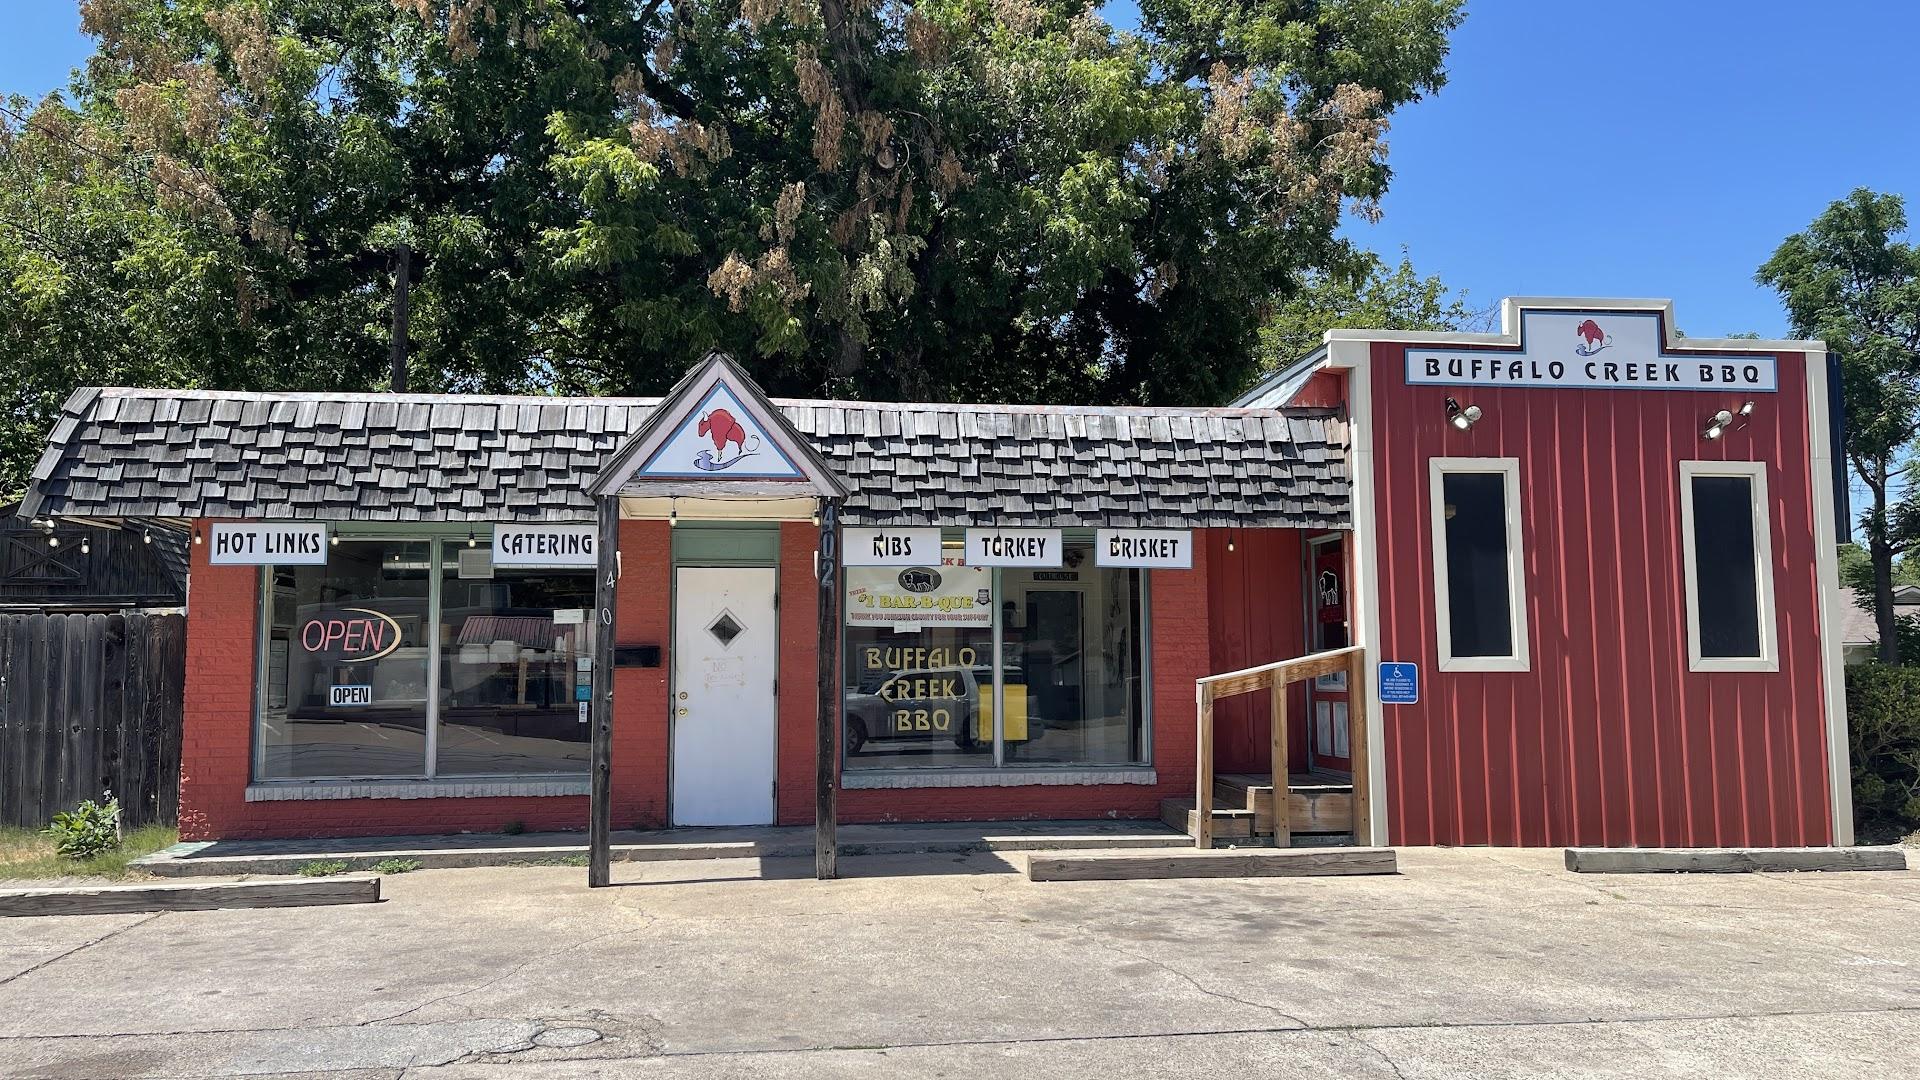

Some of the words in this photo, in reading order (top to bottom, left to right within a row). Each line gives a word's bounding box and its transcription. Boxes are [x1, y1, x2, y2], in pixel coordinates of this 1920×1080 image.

[1425, 358, 1564, 381] BUFFALO
[1584, 362, 1680, 382] CREEK
[1699, 364, 1759, 383] BBQ
[217, 532, 256, 556] HOT
[265, 532, 320, 554] LINKS
[501, 533, 593, 556] CATERING
[821, 505, 835, 586] 402
[873, 537, 912, 558] RIBS
[1110, 537, 1179, 559] BRISKET
[858, 593, 875, 608] #1
[880, 595, 974, 613] BAR-B-QUE
[302, 619, 385, 652] OPEN
[866, 646, 977, 671] BUFFALO
[333, 687, 369, 704] OPEN
[880, 679, 960, 703] CREEK
[896, 709, 951, 731] BBQ
